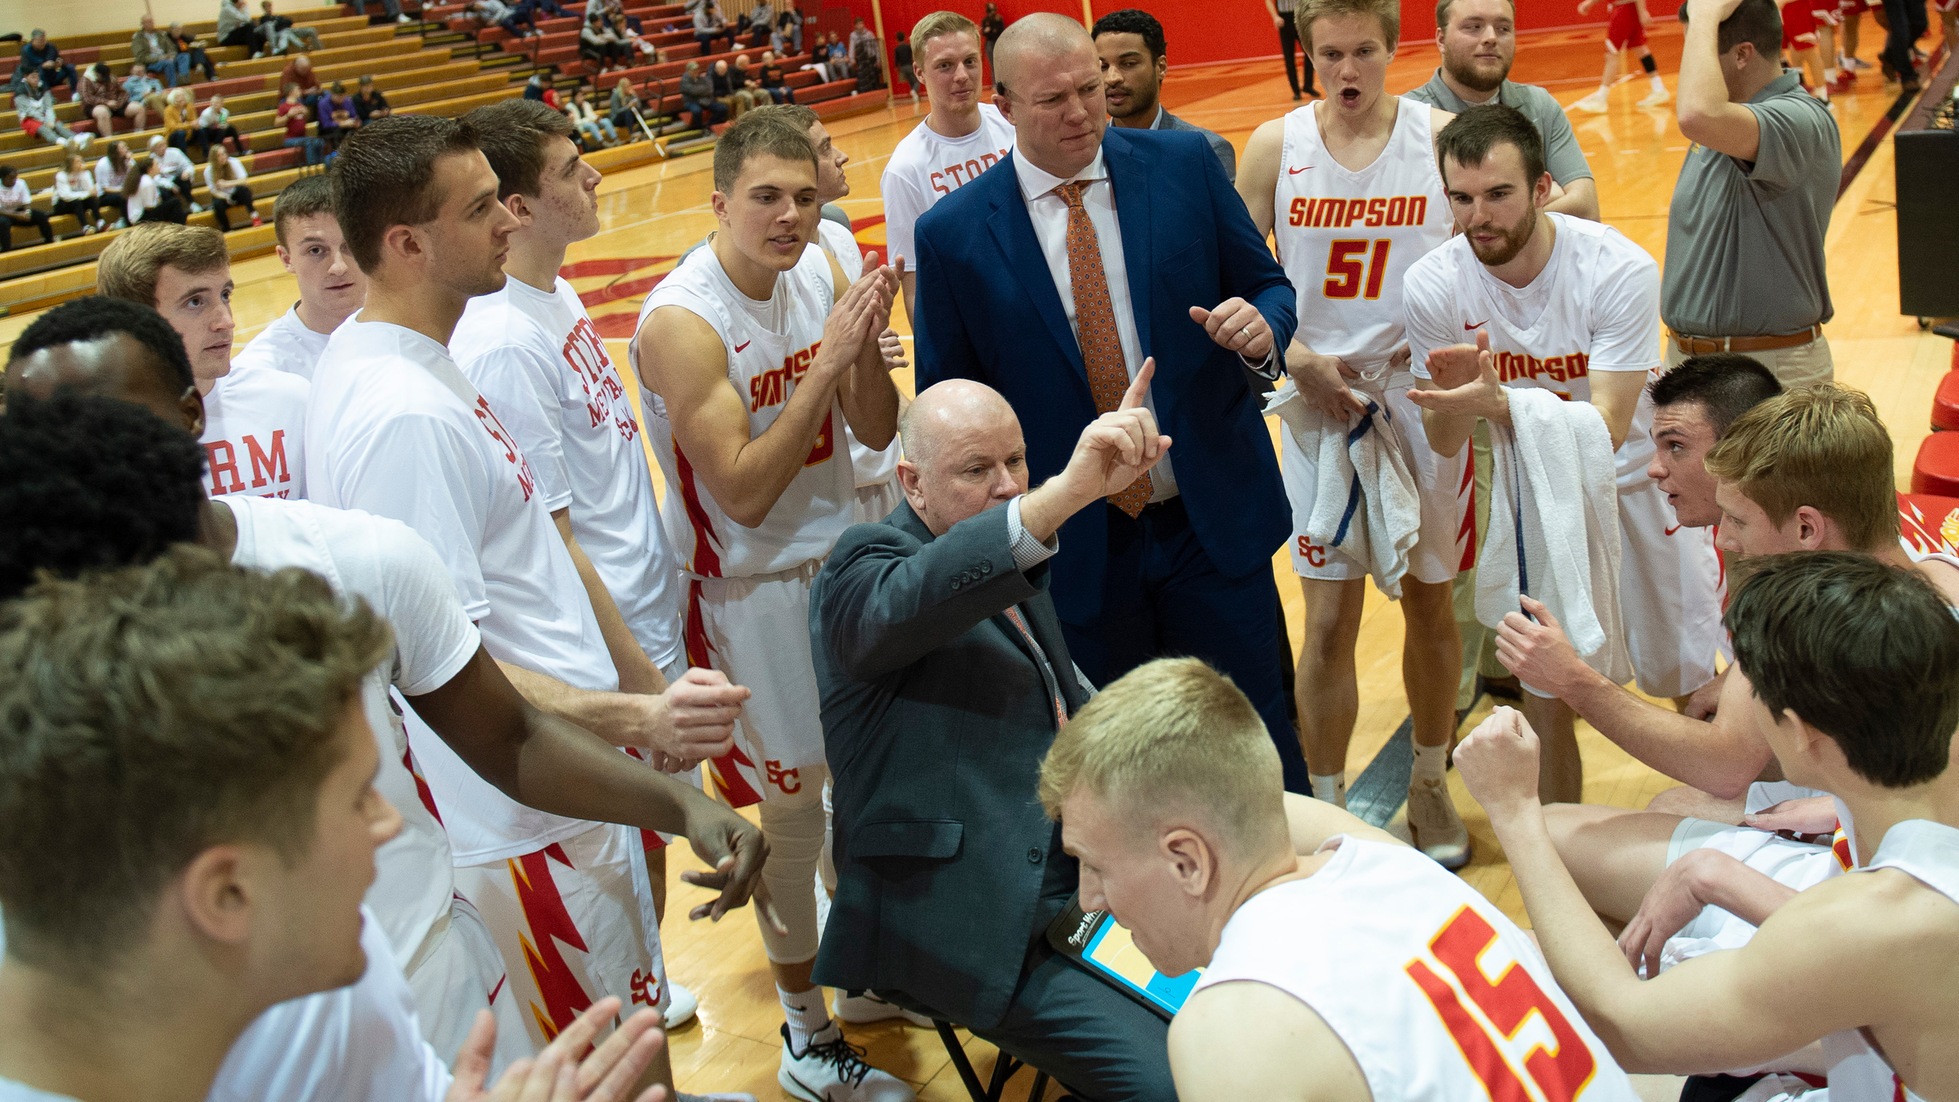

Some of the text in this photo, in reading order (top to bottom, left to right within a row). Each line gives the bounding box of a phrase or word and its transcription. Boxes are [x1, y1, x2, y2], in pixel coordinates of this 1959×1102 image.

[1289, 195, 1428, 228] SIMPSON
[1323, 238, 1392, 301] 51
[1297, 535, 1327, 568] SC
[764, 760, 802, 795] SC
[1067, 920, 1089, 946] Sport
[630, 967, 661, 1007] SC
